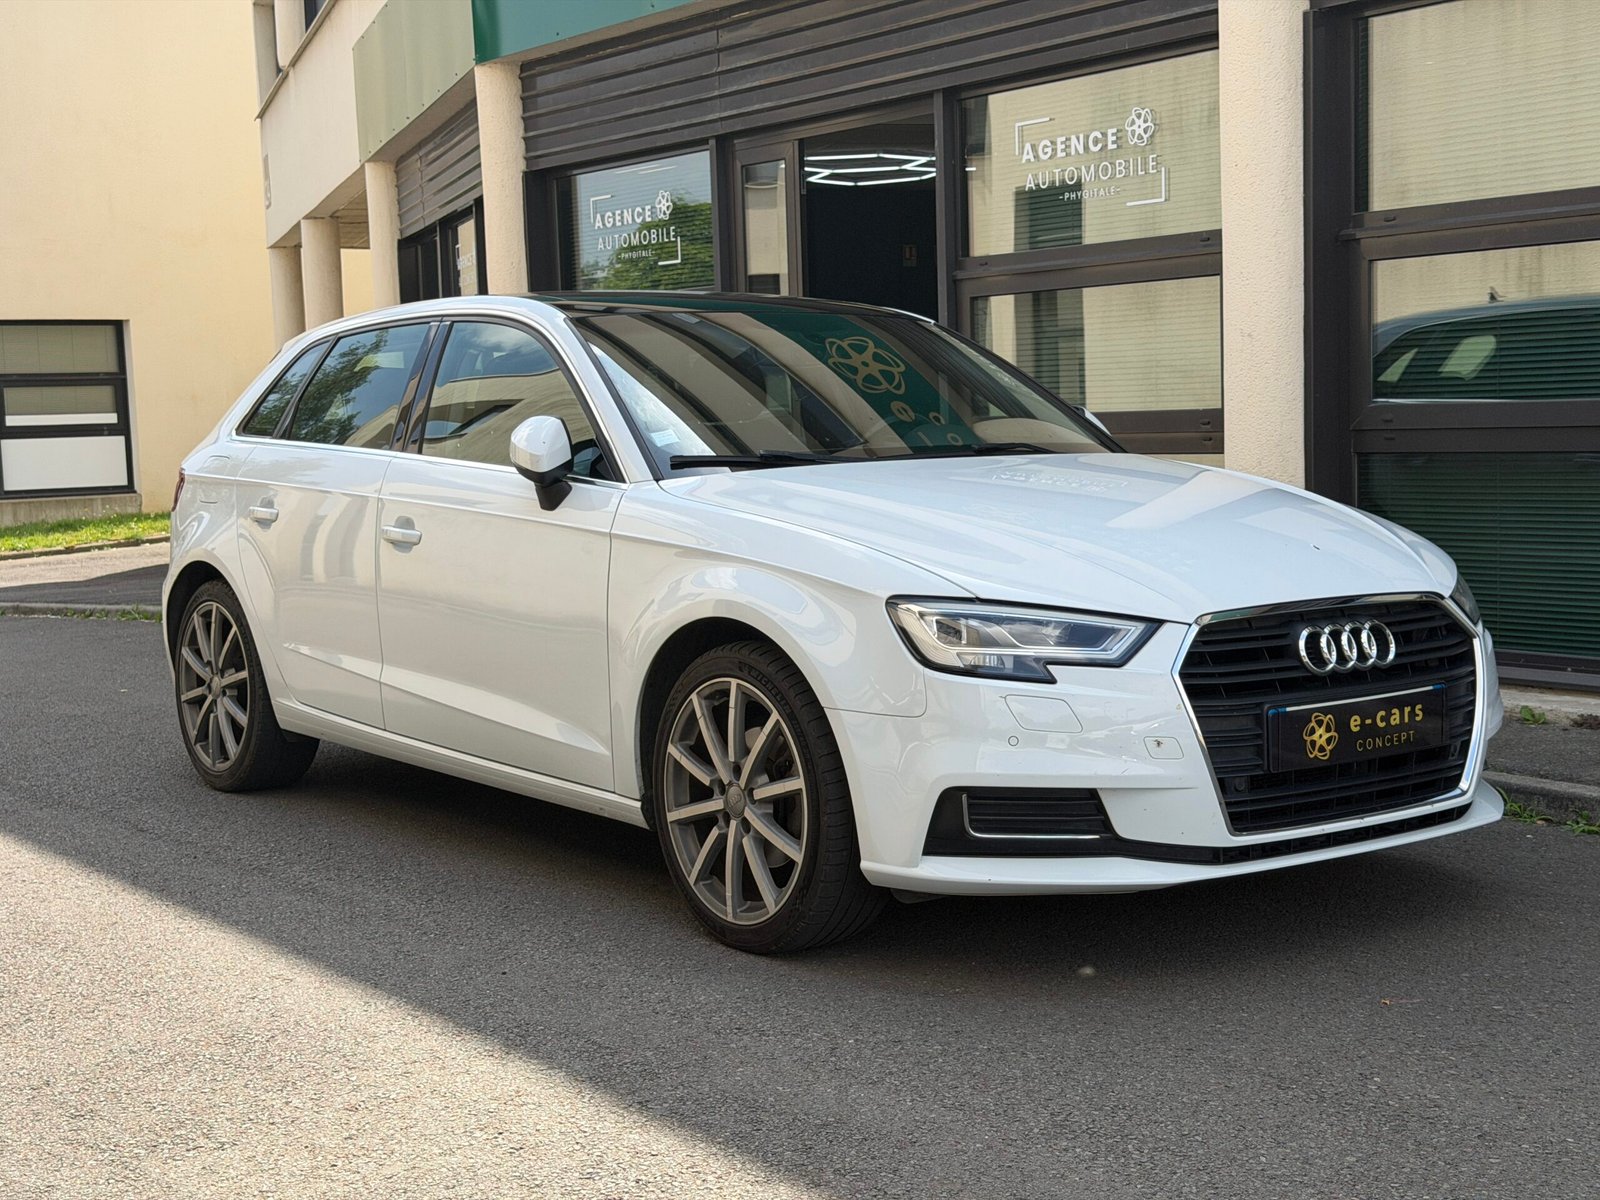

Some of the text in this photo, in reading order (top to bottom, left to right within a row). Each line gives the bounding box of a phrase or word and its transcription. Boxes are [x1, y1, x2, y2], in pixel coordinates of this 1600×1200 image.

[1022, 127, 1118, 164] AGENCE
[1025, 154, 1158, 192] AUTOMOBILE
[594, 205, 652, 230] AGENCE
[597, 226, 676, 251] AUTOMOBILE
[1349, 703, 1424, 732] e-cars
[1356, 730, 1416, 752] CONCEPT
